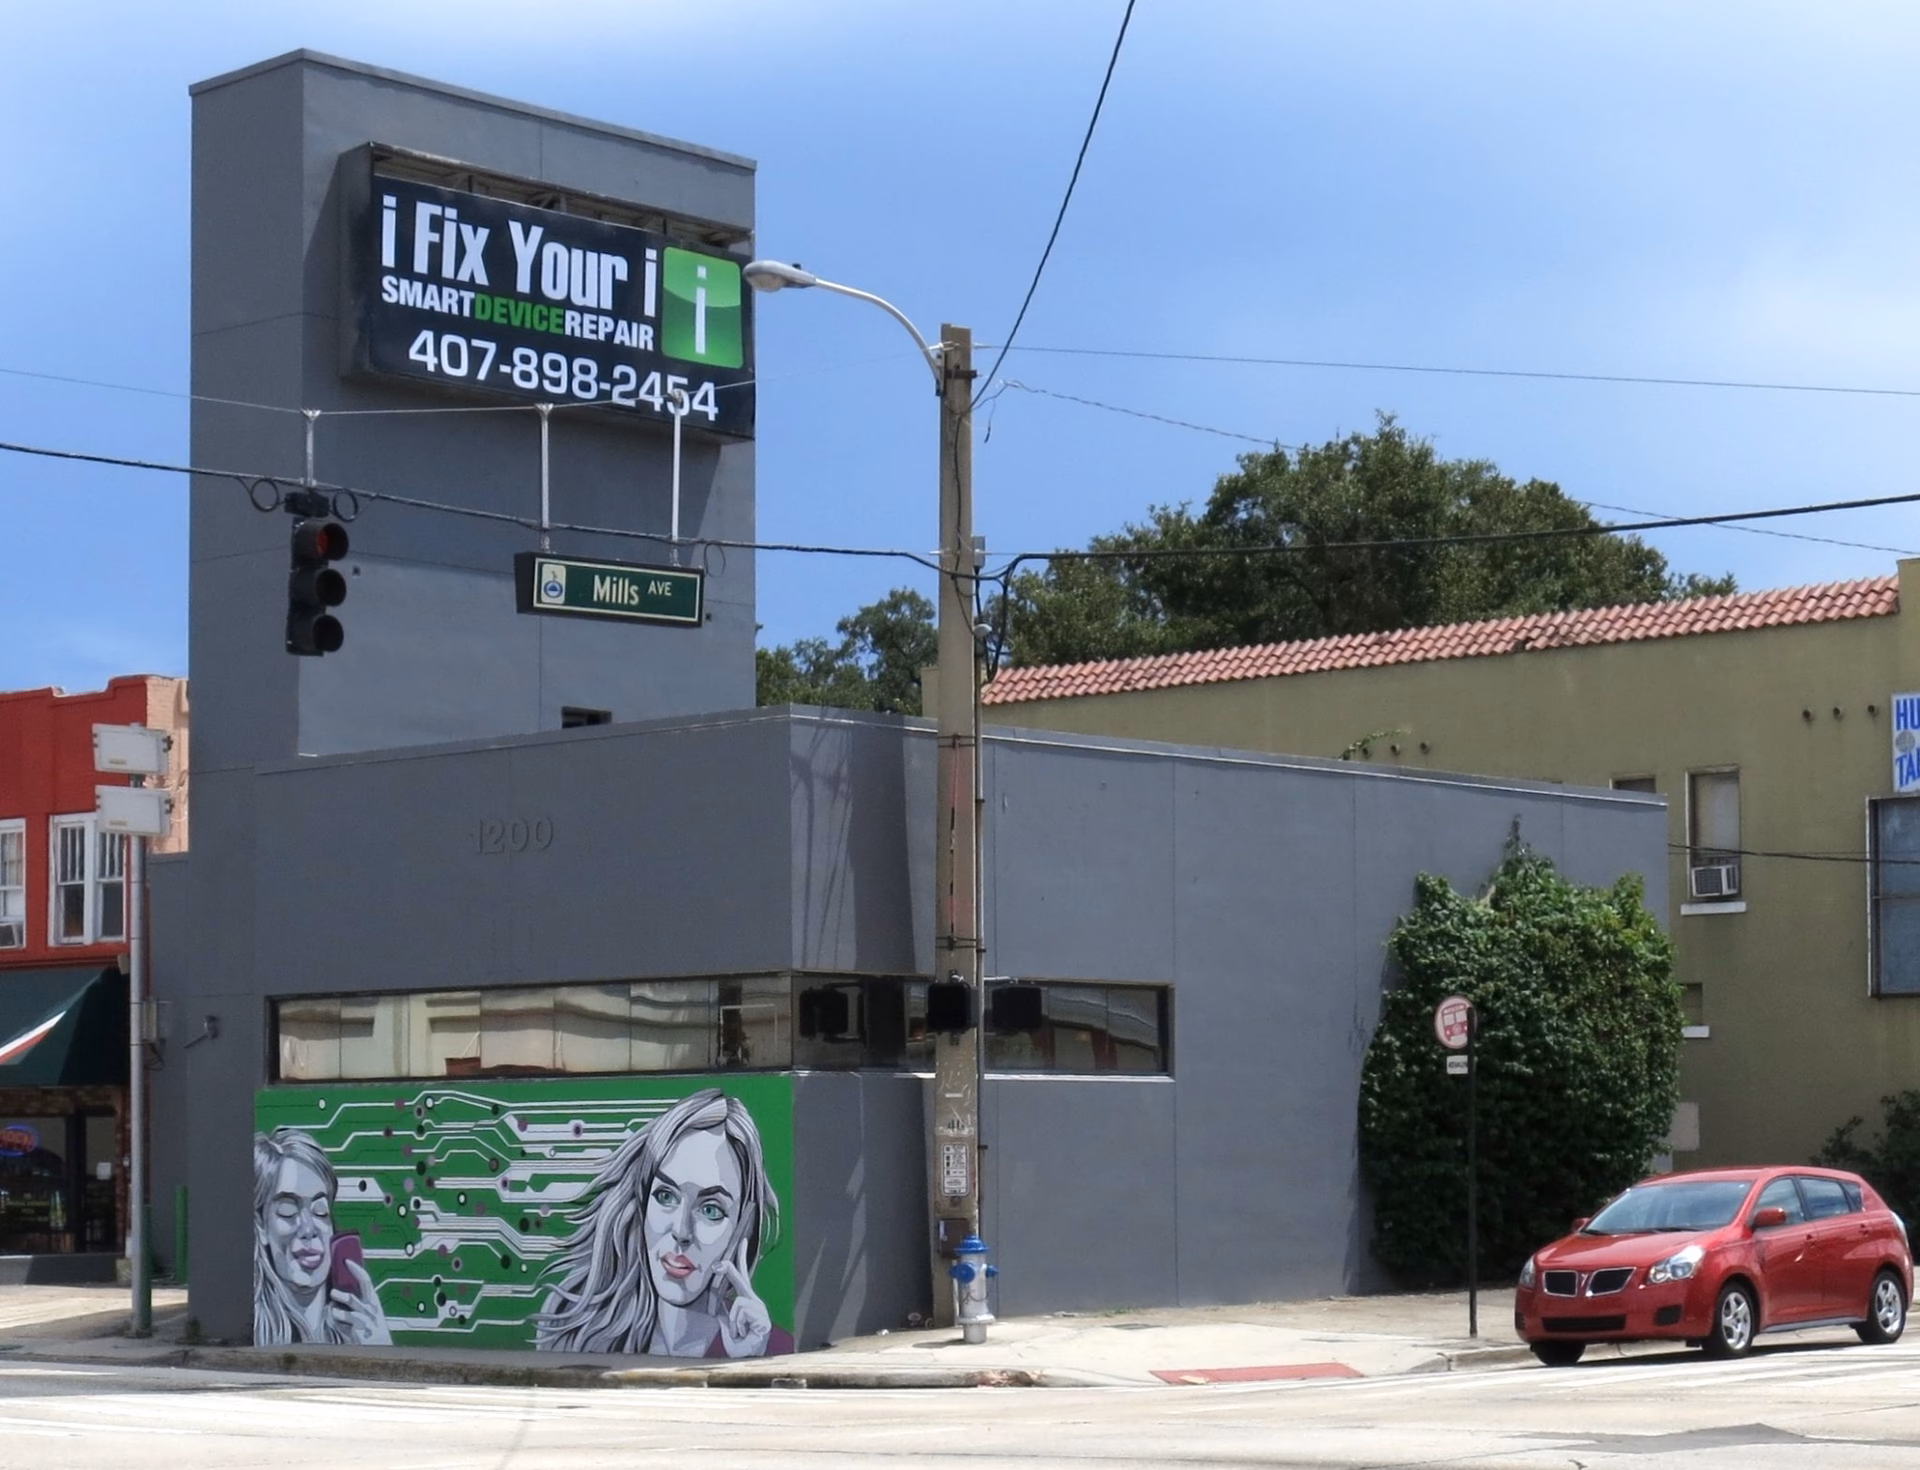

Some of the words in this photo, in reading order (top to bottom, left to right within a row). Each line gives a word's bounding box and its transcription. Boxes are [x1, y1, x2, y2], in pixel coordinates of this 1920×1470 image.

[382, 194, 397, 268] i
[413, 201, 490, 286] Fix
[508, 219, 628, 311] Your
[644, 248, 658, 317] i
[409, 329, 719, 422] 407-898-2454
[593, 574, 639, 606] Mills
[648, 580, 672, 596] AVE
[476, 817, 554, 855] 1200
